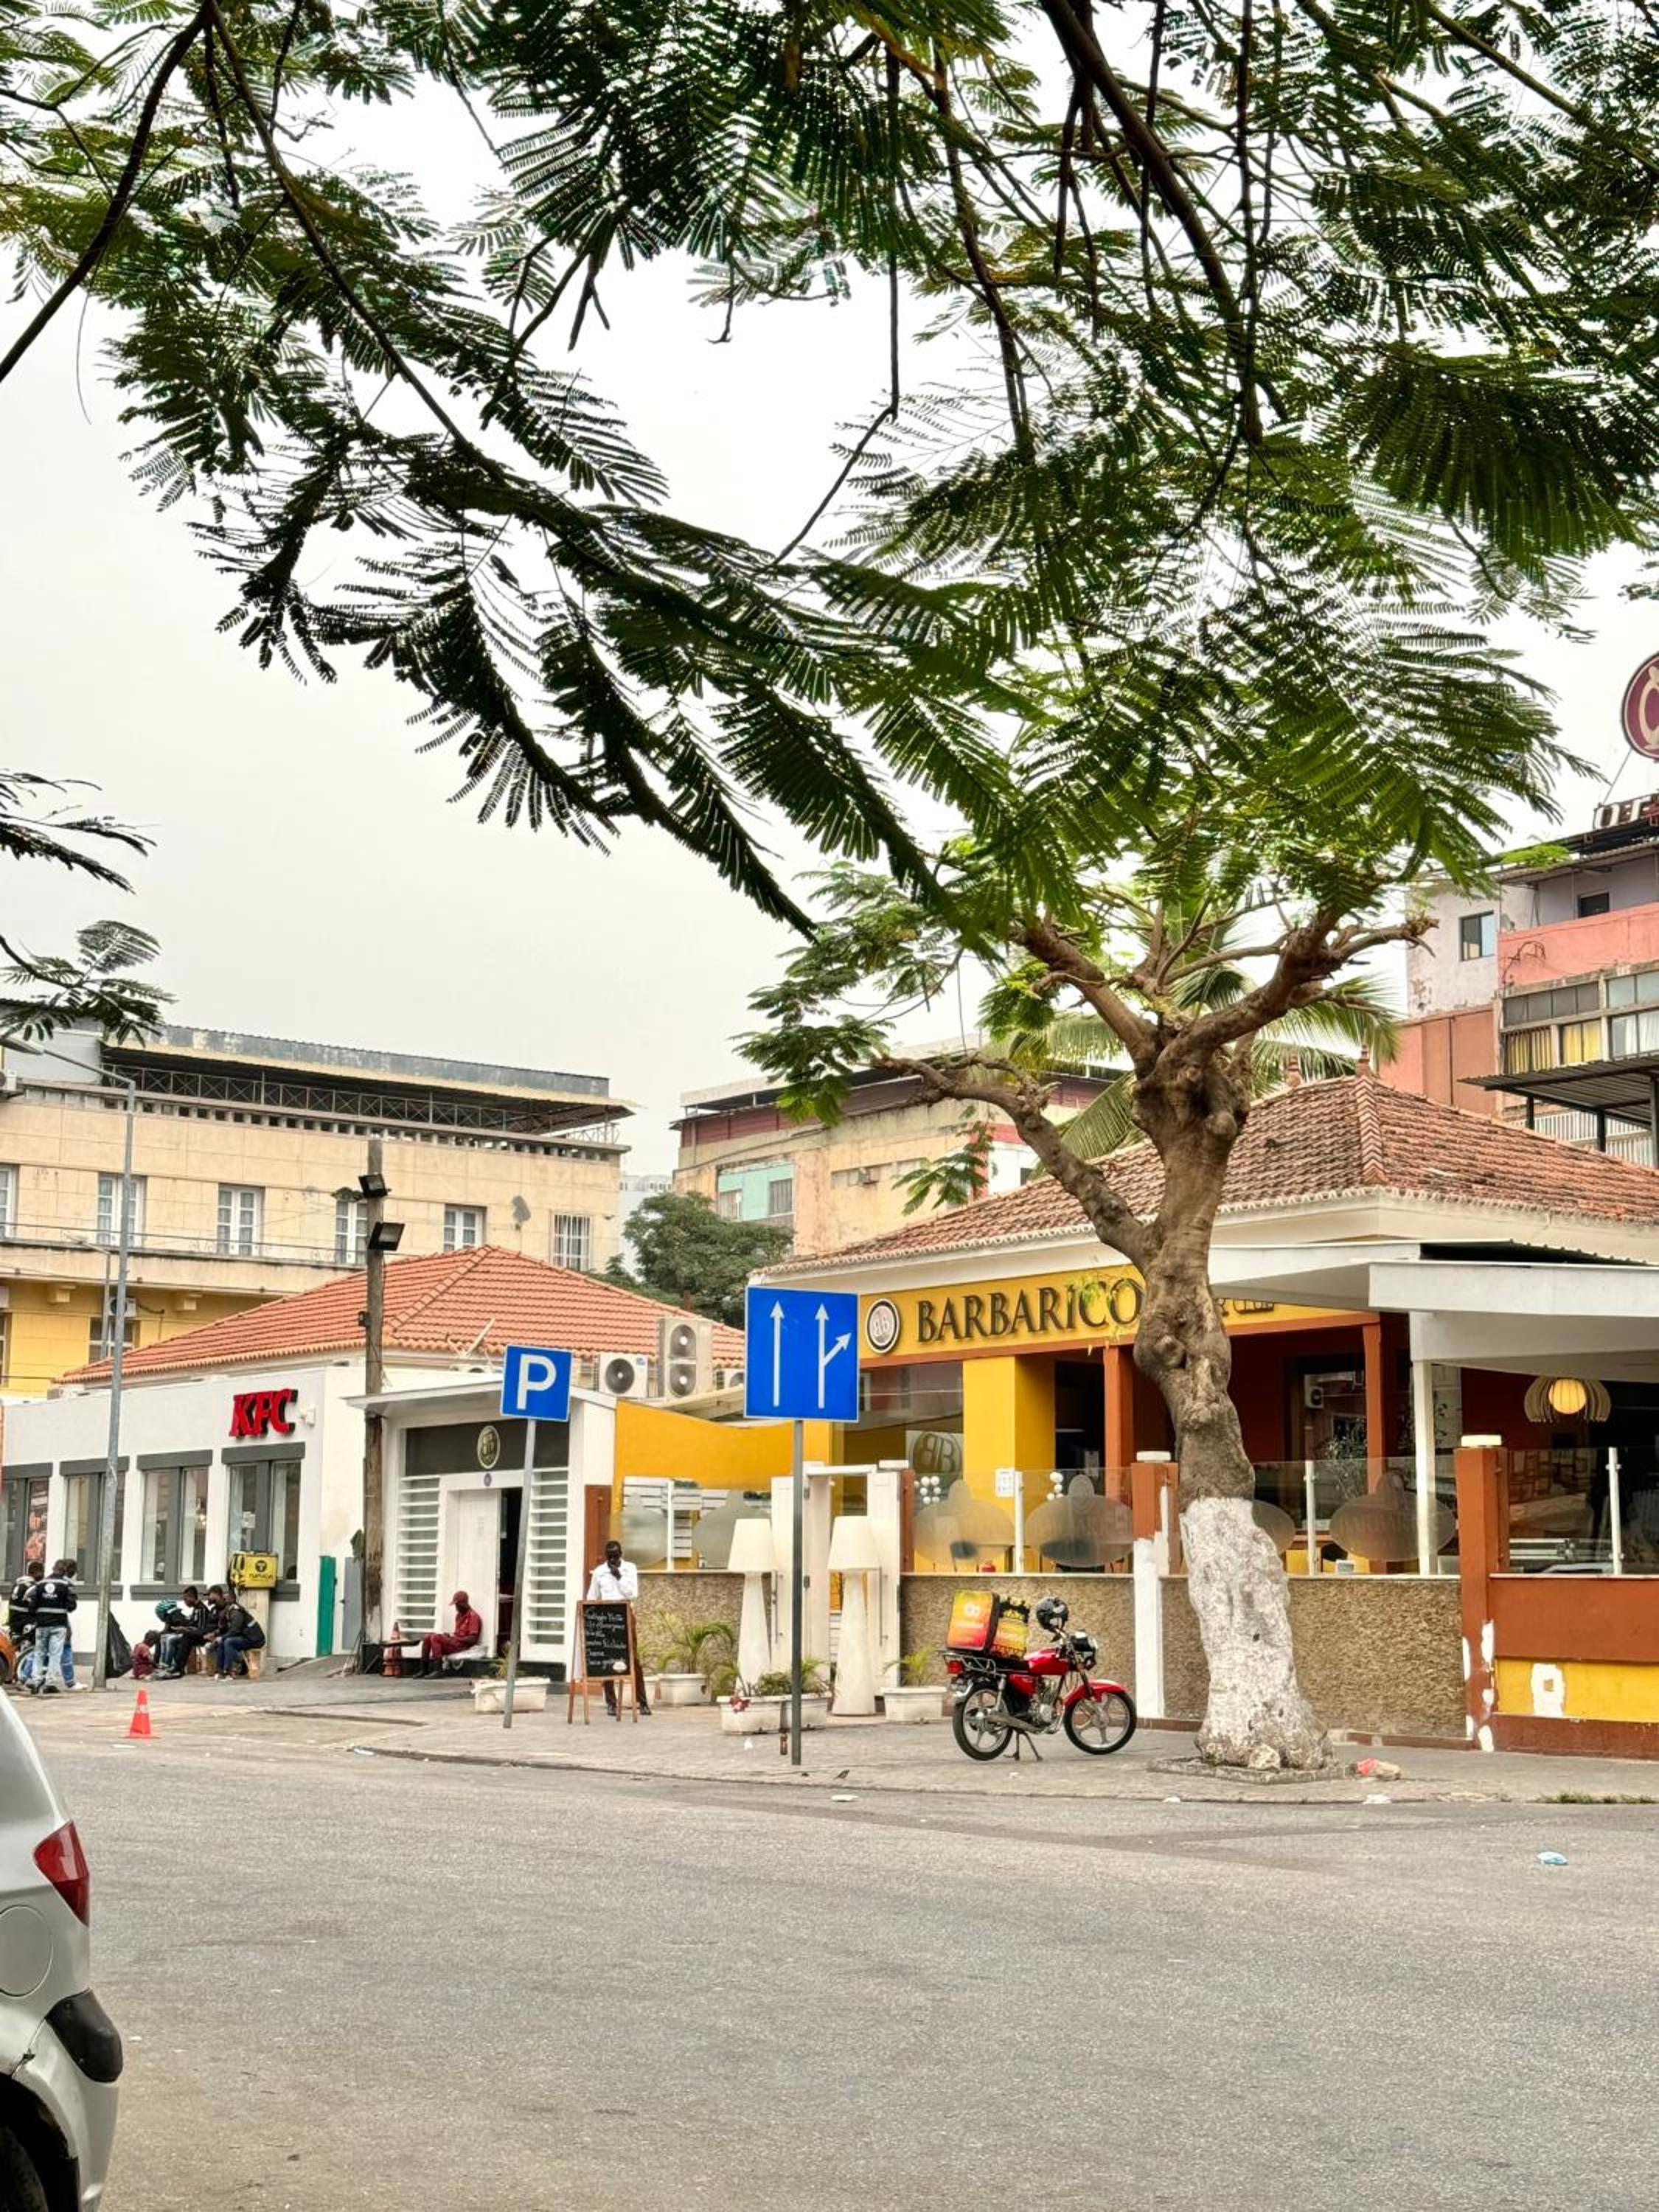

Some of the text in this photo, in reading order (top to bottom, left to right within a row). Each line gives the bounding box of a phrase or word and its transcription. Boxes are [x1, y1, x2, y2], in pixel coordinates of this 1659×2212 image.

[917, 1278, 1142, 1343] BARBARICO
[517, 1354, 557, 1410] P
[229, 1388, 298, 1439] KFC
